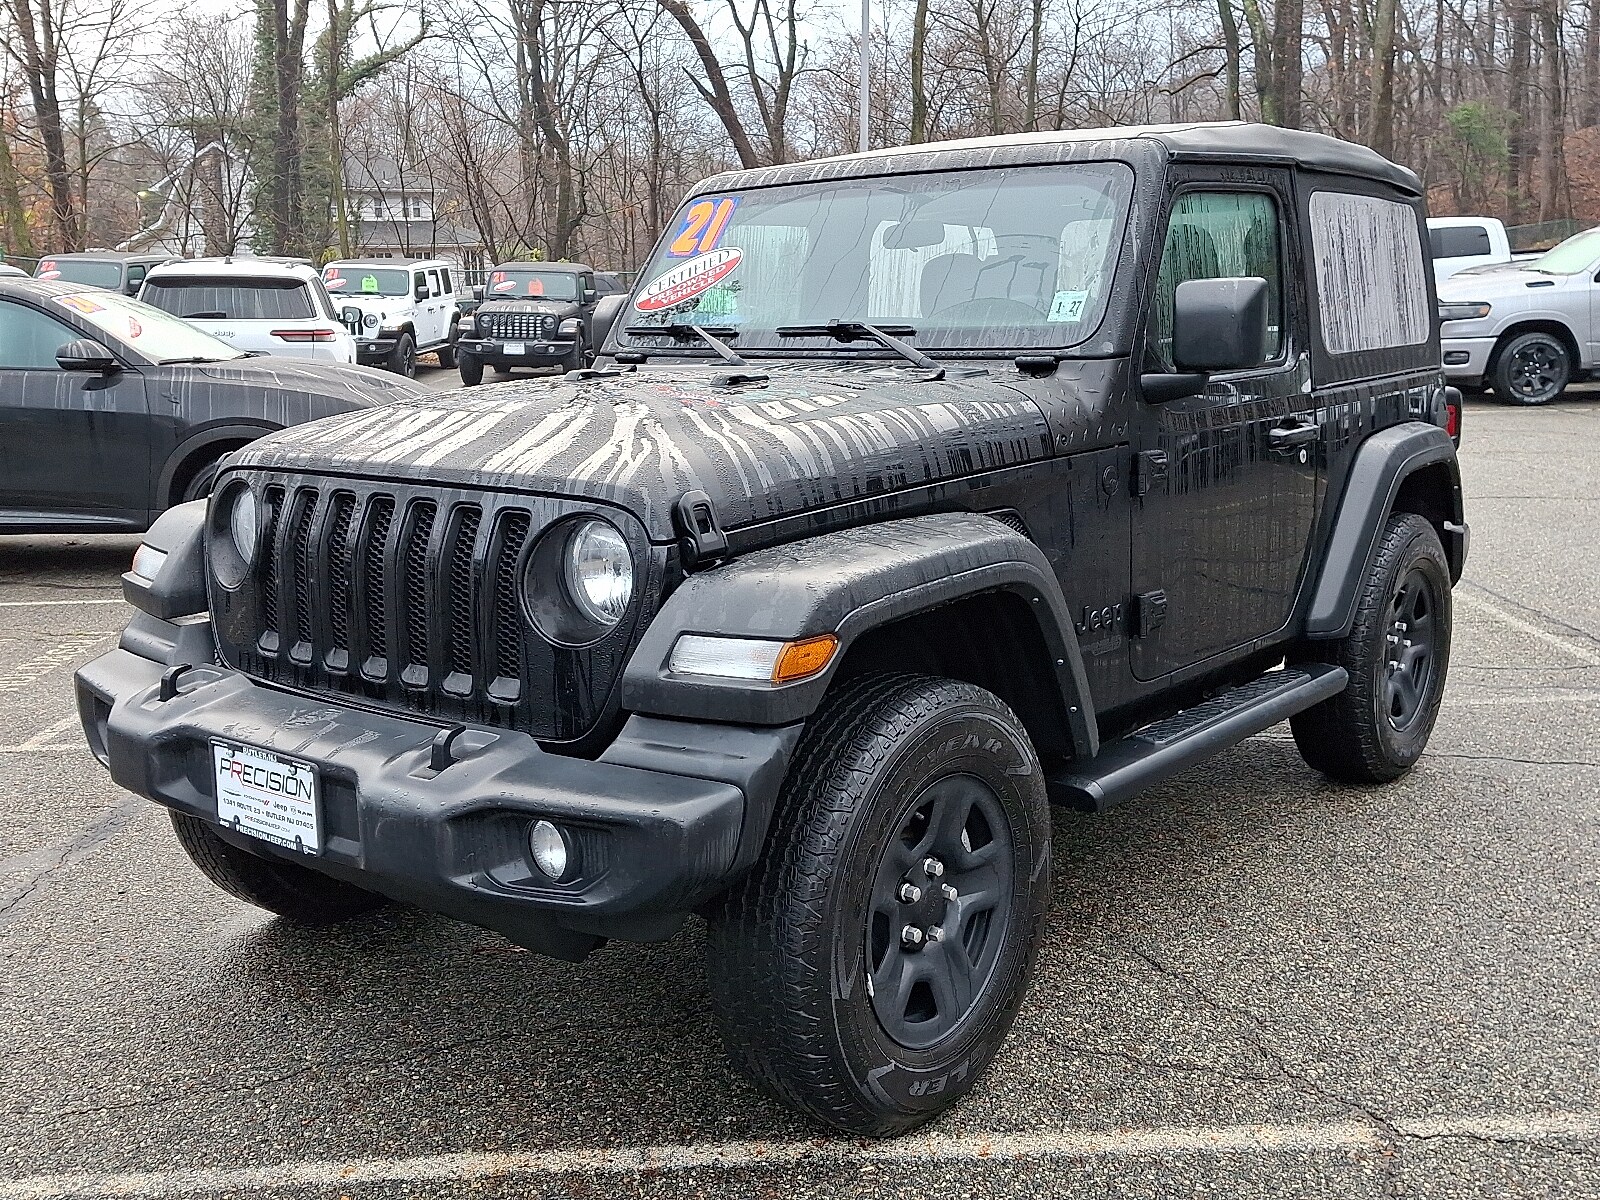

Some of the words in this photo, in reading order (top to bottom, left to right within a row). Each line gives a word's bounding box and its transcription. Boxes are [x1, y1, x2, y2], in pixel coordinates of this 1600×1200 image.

[670, 199, 735, 256] 21
[648, 250, 730, 296] CERTIFIED
[650, 264, 728, 304] PRE-OWNED
[661, 277, 715, 304] VEHICLE
[1069, 300, 1082, 315] 27
[1075, 603, 1122, 636] Jeep
[219, 757, 313, 801] PRECISION
[237, 801, 253, 813] ROUTE
[254, 807, 261, 815] 23
[265, 810, 286, 822] BUTLER
[286, 816, 295, 825] NJ
[296, 819, 314, 830] 07405
[272, 801, 288, 812] Jeep
[235, 823, 297, 851] PRECISIONJEEP.COM
